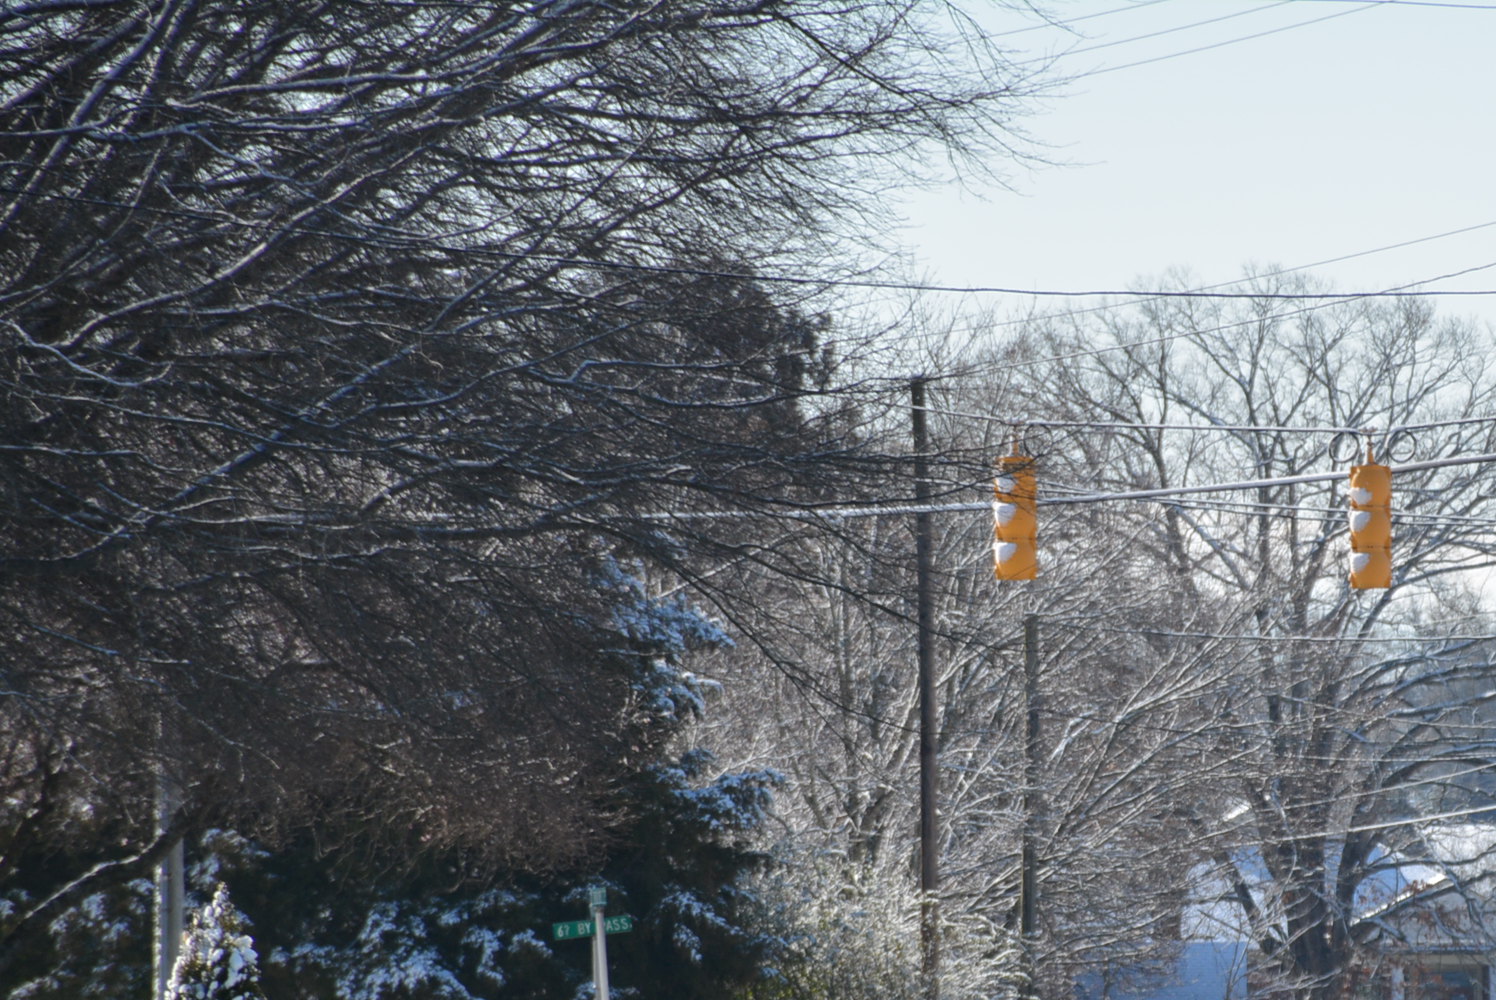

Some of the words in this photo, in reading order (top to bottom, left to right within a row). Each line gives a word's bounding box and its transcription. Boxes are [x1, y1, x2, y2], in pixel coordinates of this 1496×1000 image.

[557, 924, 570, 938] 67
[578, 922, 592, 936] BY
[602, 918, 628, 932] ASS
